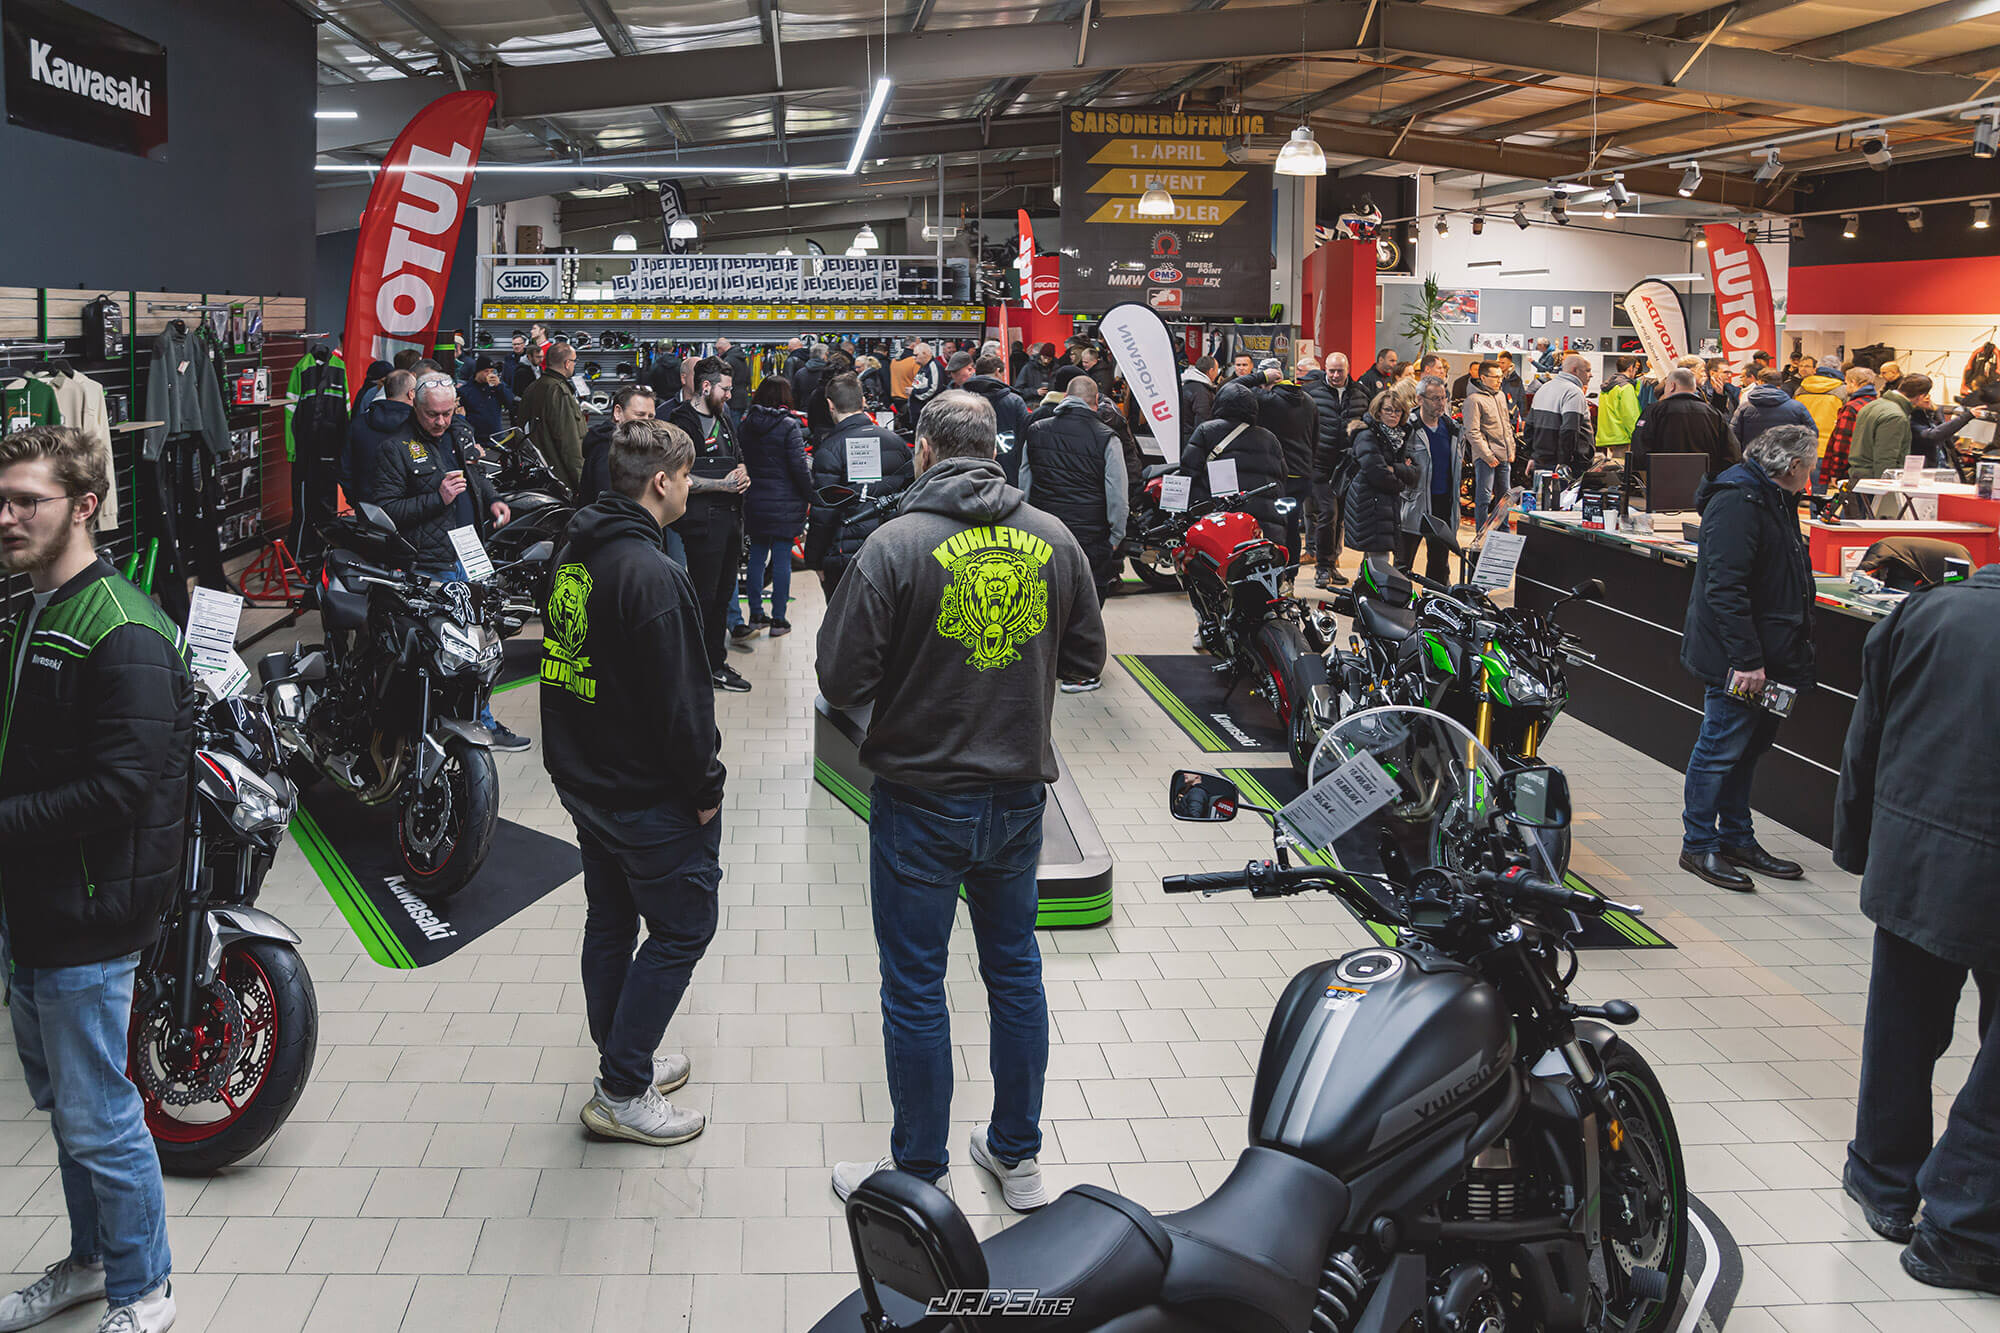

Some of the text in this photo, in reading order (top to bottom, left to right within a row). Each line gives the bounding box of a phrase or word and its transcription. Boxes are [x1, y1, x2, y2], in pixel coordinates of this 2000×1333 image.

[29, 39, 151, 117] Kawasaki
[1129, 145, 1206, 161] 1. APRIL
[1129, 174, 1136, 189] 1
[1113, 204, 1220, 221] 7 HDLER
[505, 275, 541, 288] SHOEI
[1108, 275, 1145, 285] MMW
[931, 526, 1053, 569] KUHLEWU
[383, 874, 457, 941] Kawasaki
